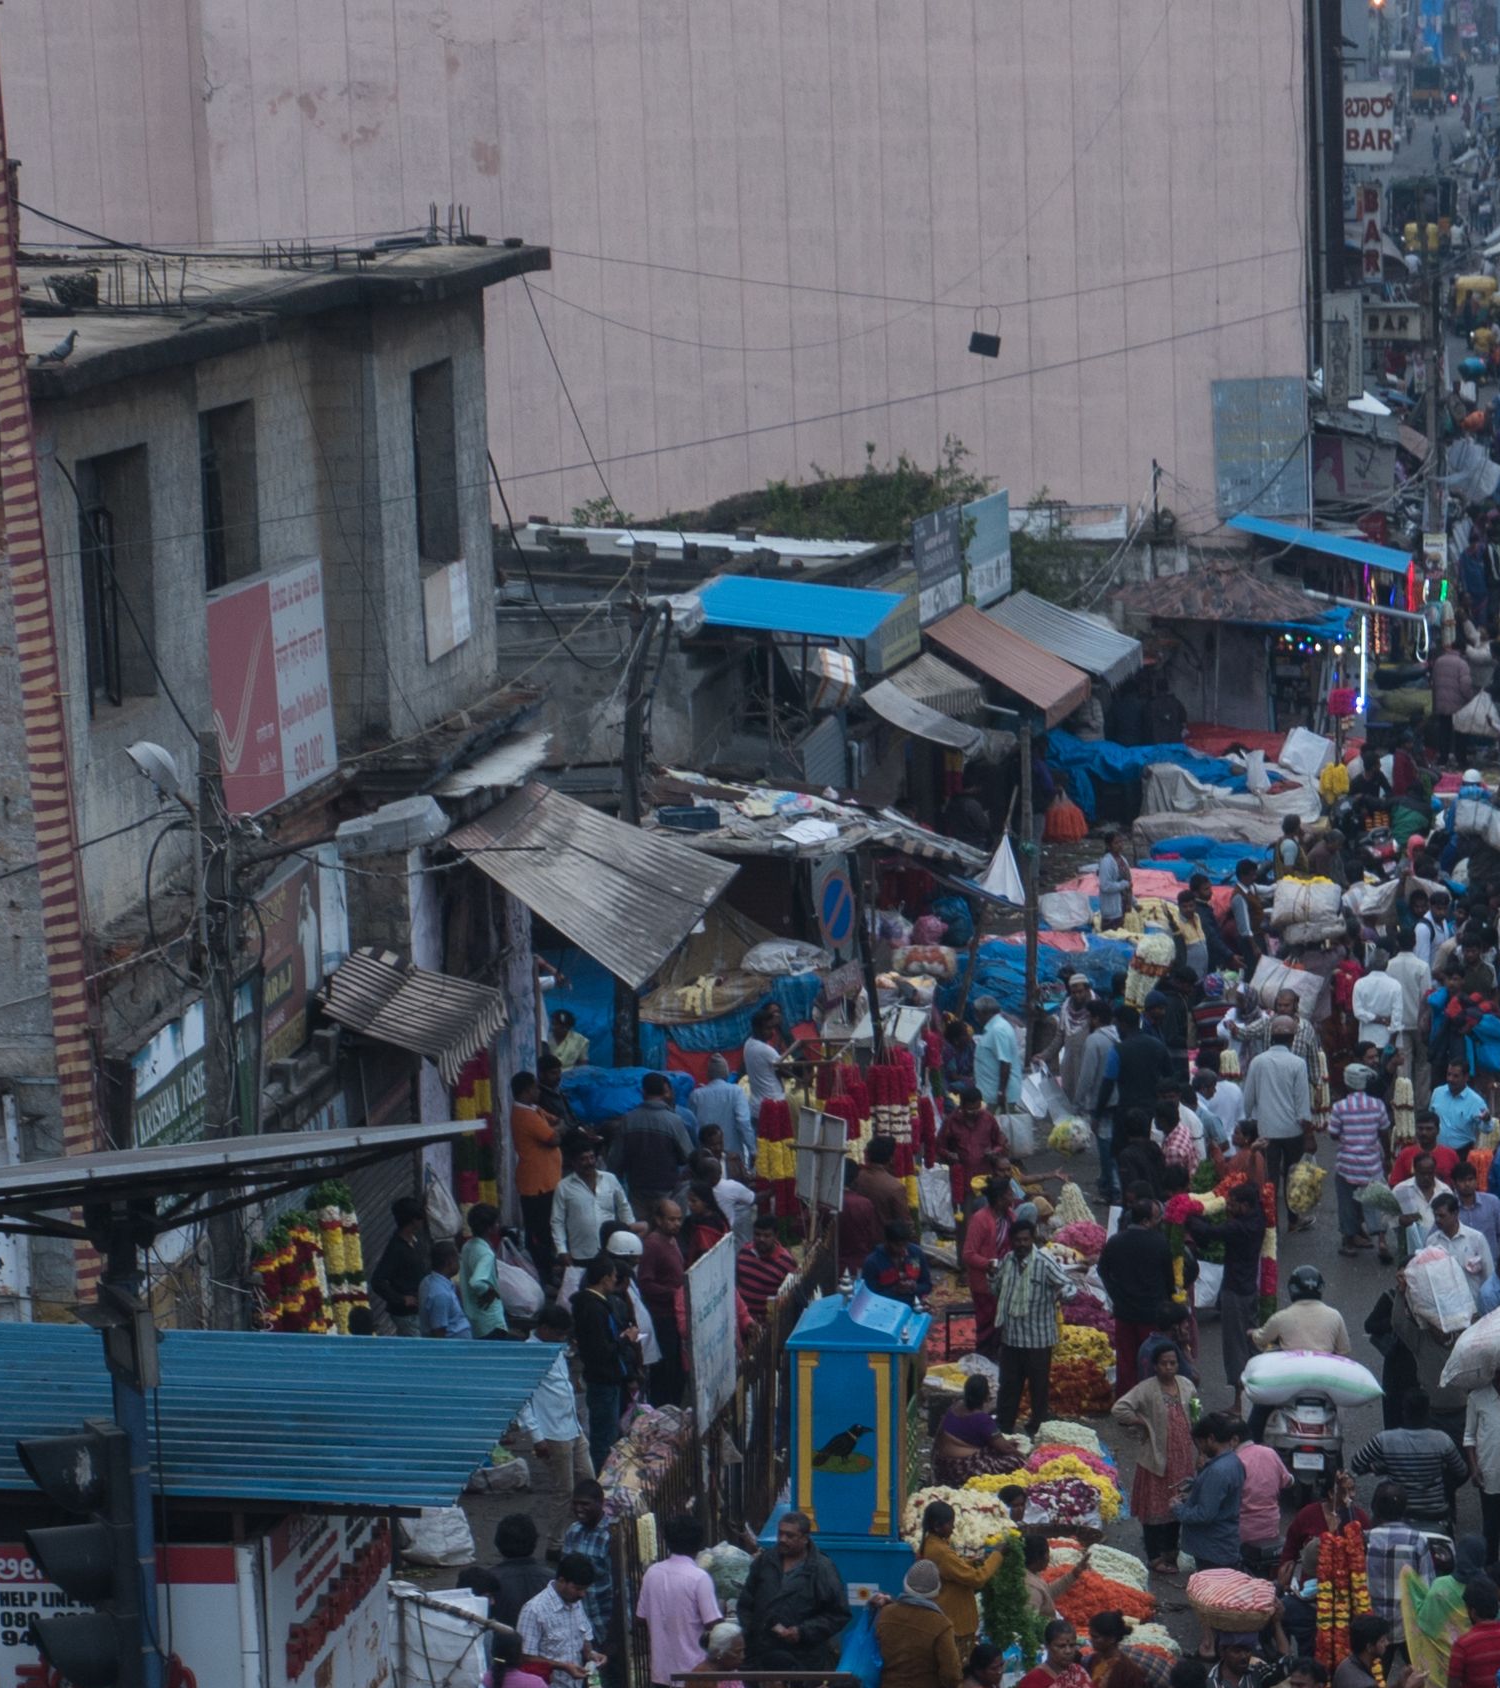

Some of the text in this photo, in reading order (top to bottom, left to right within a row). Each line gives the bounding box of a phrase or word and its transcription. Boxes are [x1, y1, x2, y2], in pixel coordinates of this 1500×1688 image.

[1344, 93, 1394, 119] ಬಾರ್
[1345, 129, 1393, 152] BAR
[1362, 186, 1382, 274] BAR
[1368, 311, 1409, 331] BAR
[0, 1590, 38, 1608] HELP
